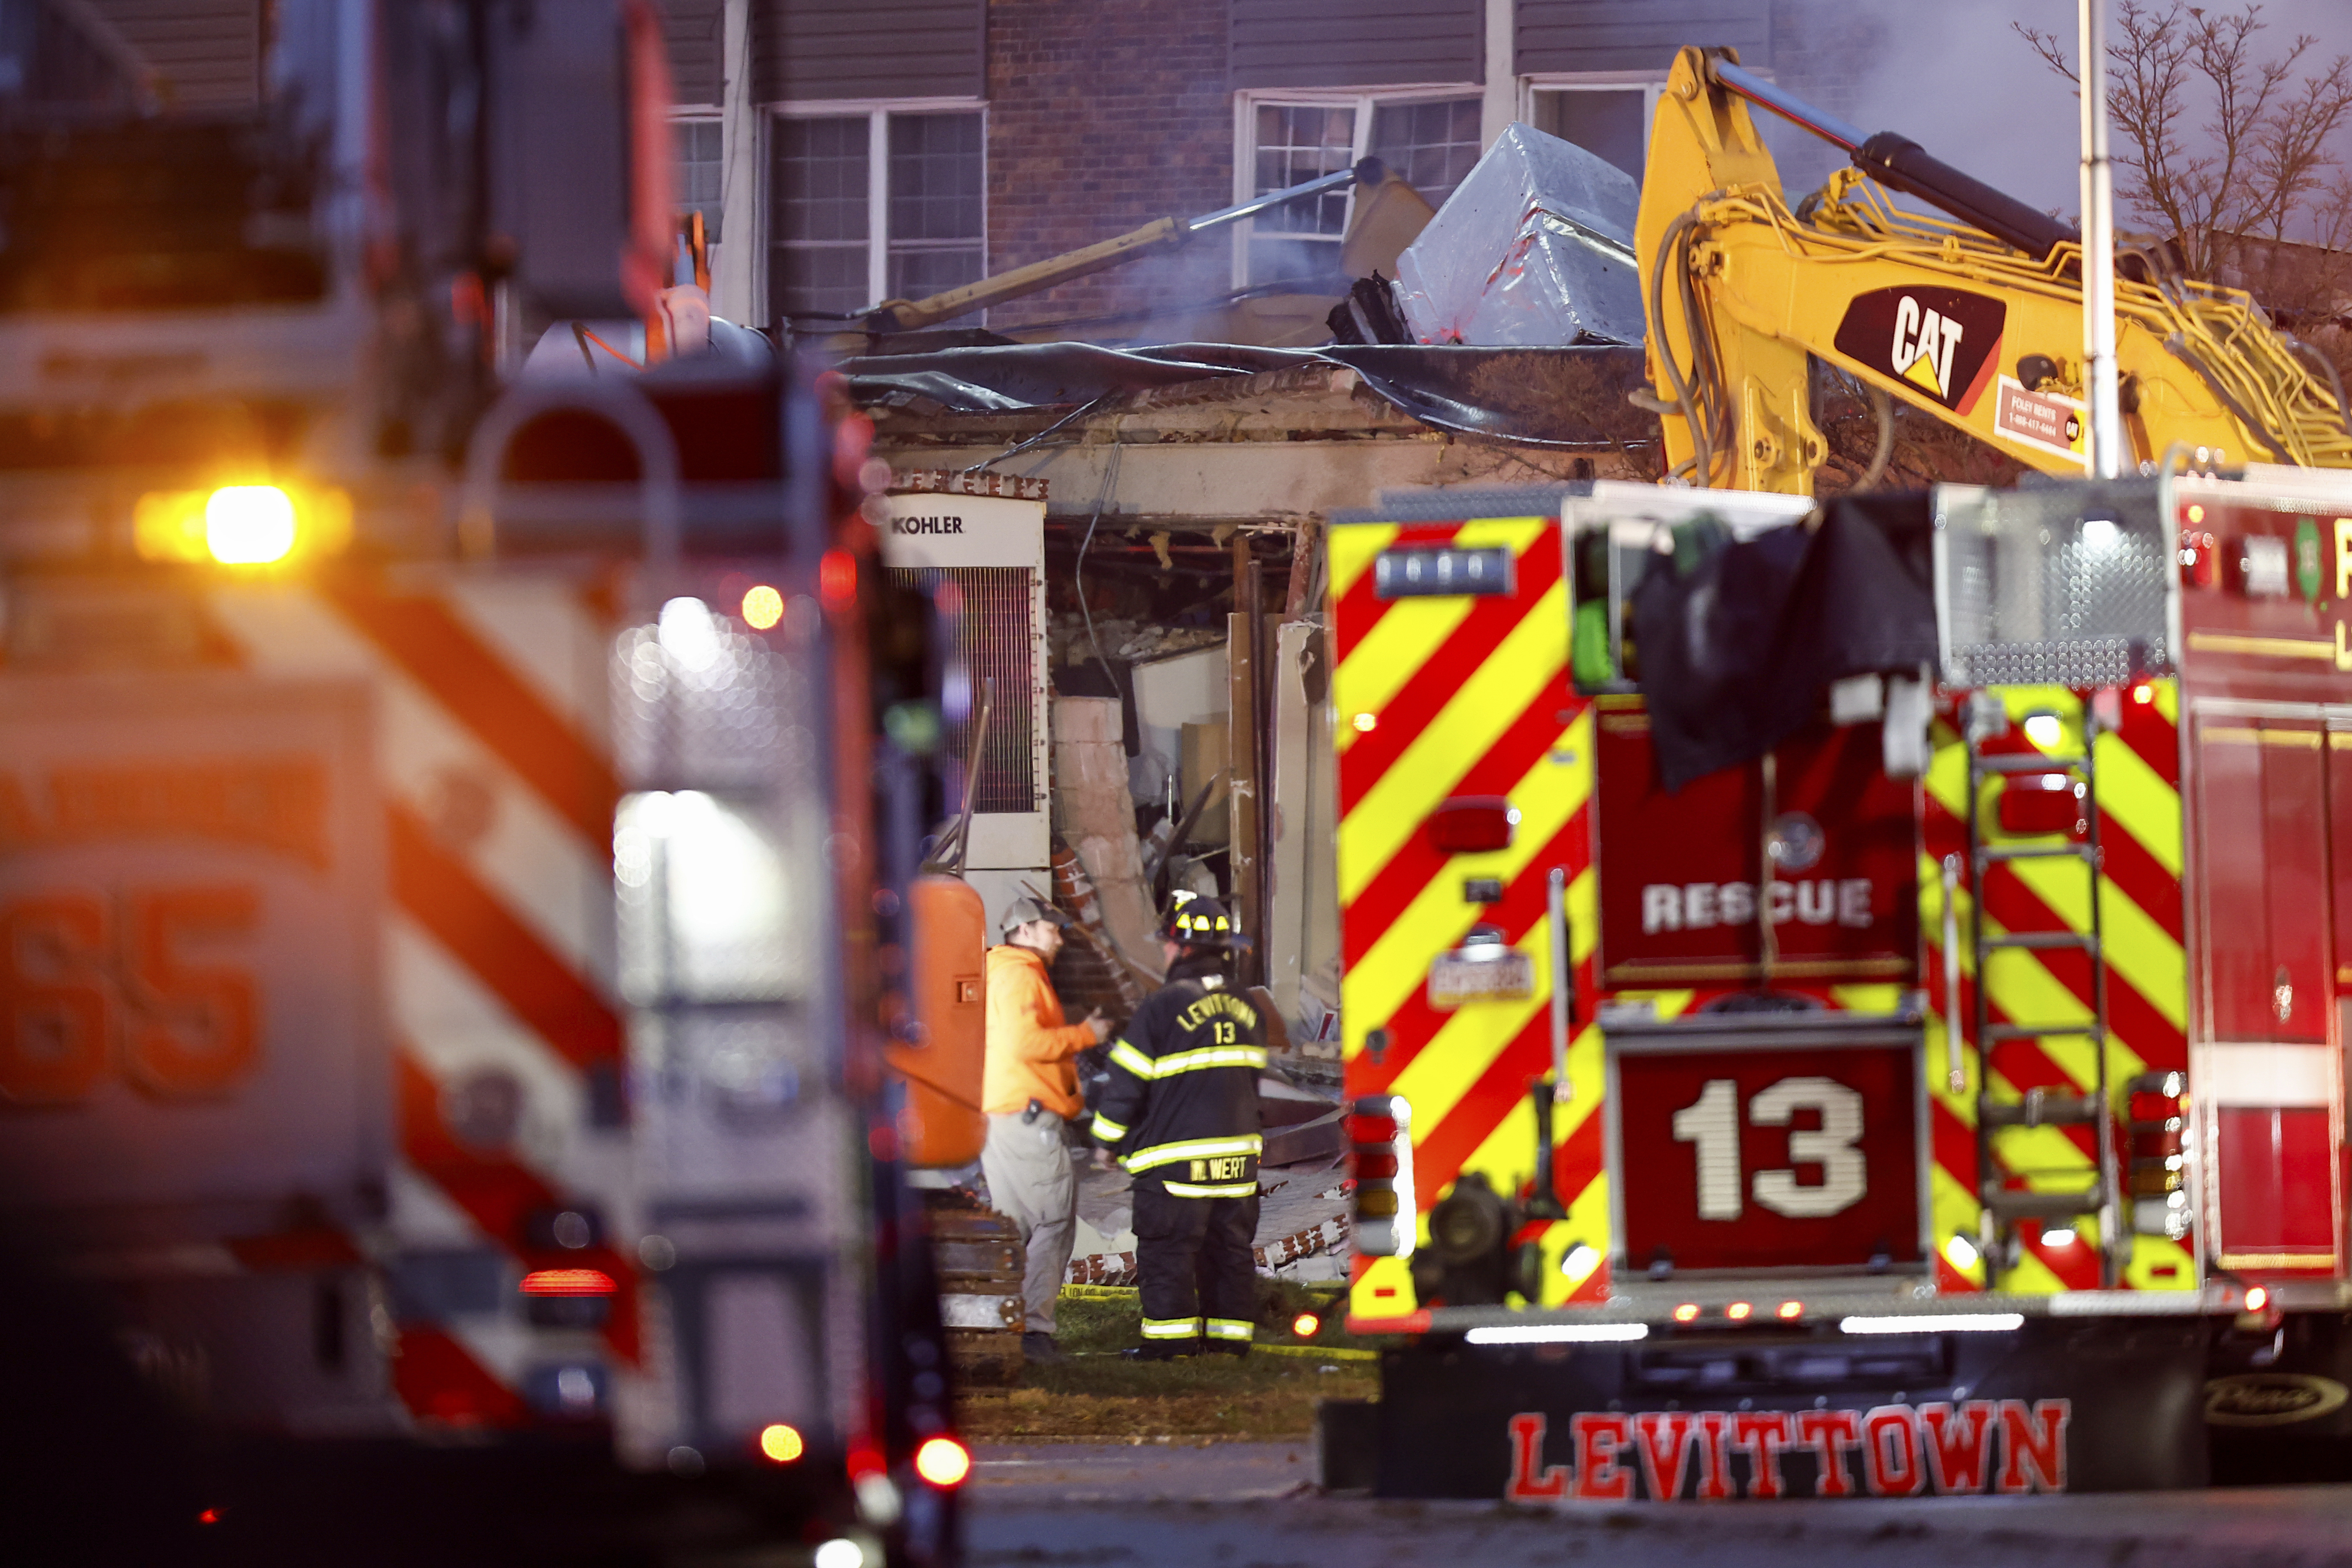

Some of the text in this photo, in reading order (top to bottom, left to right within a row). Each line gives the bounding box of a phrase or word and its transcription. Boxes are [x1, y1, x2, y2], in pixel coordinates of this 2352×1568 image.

[1891, 295, 1963, 400] CAT
[2011, 395, 2033, 413] FOLEY
[2066, 421, 2078, 438] CAT
[892, 516, 964, 535] KOHLER
[1642, 877, 1874, 935] RESCUE
[1214, 1021, 1236, 1044] 13
[1672, 1076, 1868, 1221] 13
[1209, 1157, 1247, 1180] WERT
[1506, 1398, 2071, 1503] LEVITTOWN
